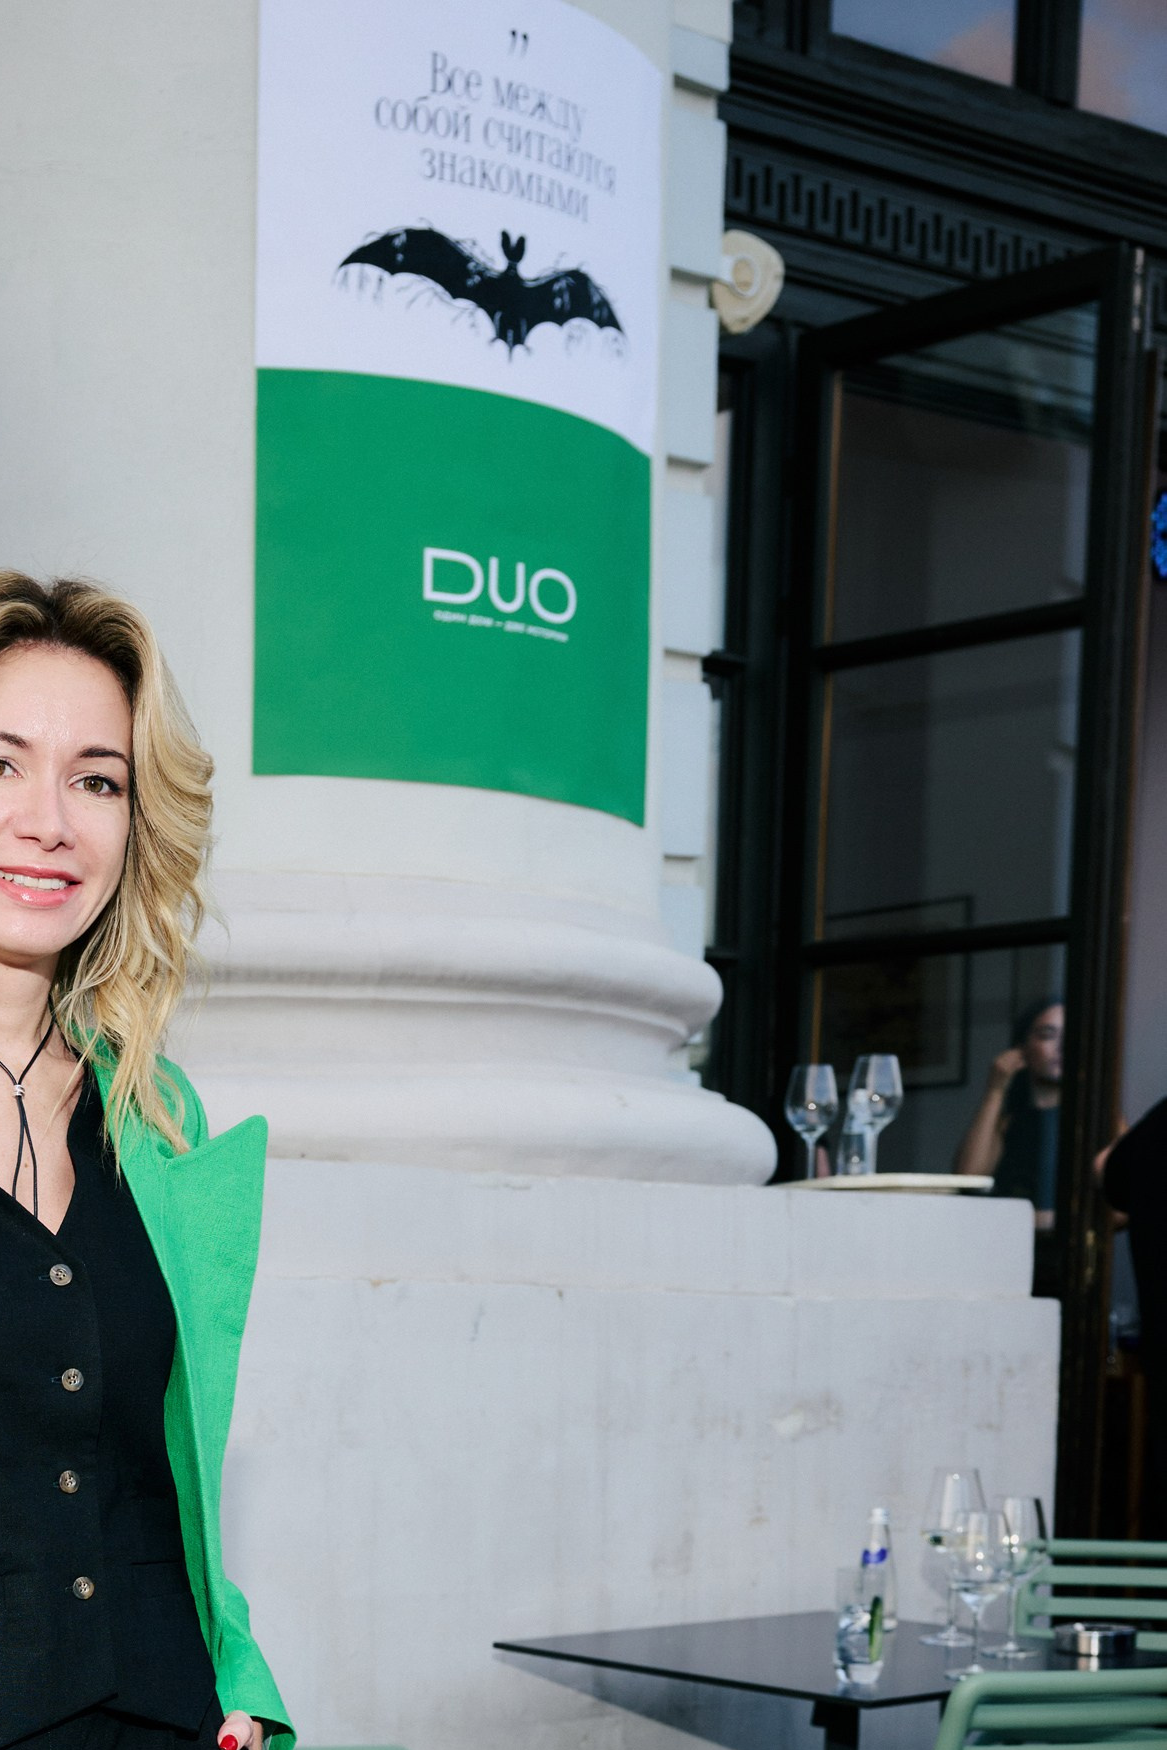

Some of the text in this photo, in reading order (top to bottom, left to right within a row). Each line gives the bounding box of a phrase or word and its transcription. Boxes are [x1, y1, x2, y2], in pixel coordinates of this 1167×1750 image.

[430, 50, 587, 143] Все между
[374, 95, 618, 197] собой считаются
[420, 147, 590, 224] знакомыми
[422, 546, 578, 625] DUO
